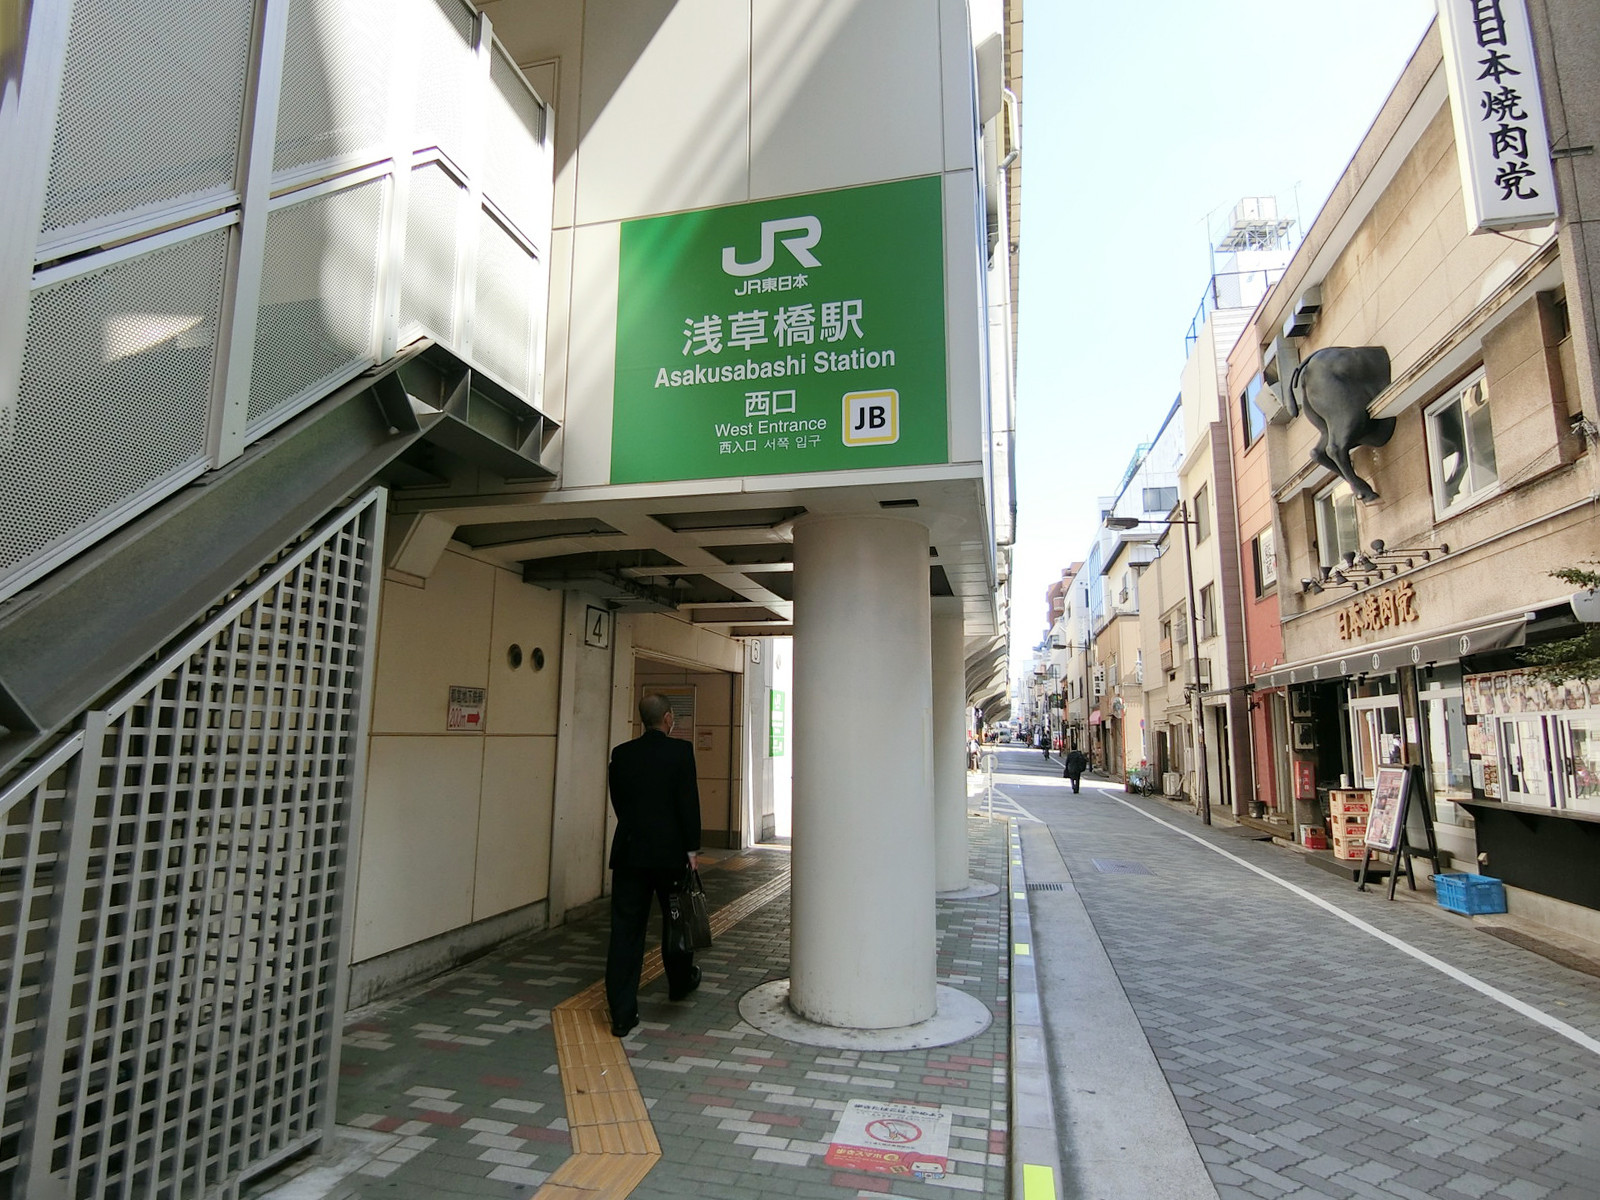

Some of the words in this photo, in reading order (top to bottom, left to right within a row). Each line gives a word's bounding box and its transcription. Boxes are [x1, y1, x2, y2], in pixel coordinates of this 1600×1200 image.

[722, 215, 822, 277] JR
[735, 273, 808, 296] JR東日本
[681, 299, 864, 357] 浅草橋駅
[654, 353, 806, 389] Asakusabashi
[814, 347, 895, 374] Station
[744, 389, 796, 418] 西口
[855, 405, 886, 431] JB
[715, 418, 753, 438] West
[758, 416, 827, 436] Entrance
[719, 439, 757, 455] 西入口
[764, 435, 790, 451] 서쪽
[795, 433, 822, 449] 입구
[1338, 580, 1419, 640] 日本焼肉党
[592, 612, 603, 644] 4
